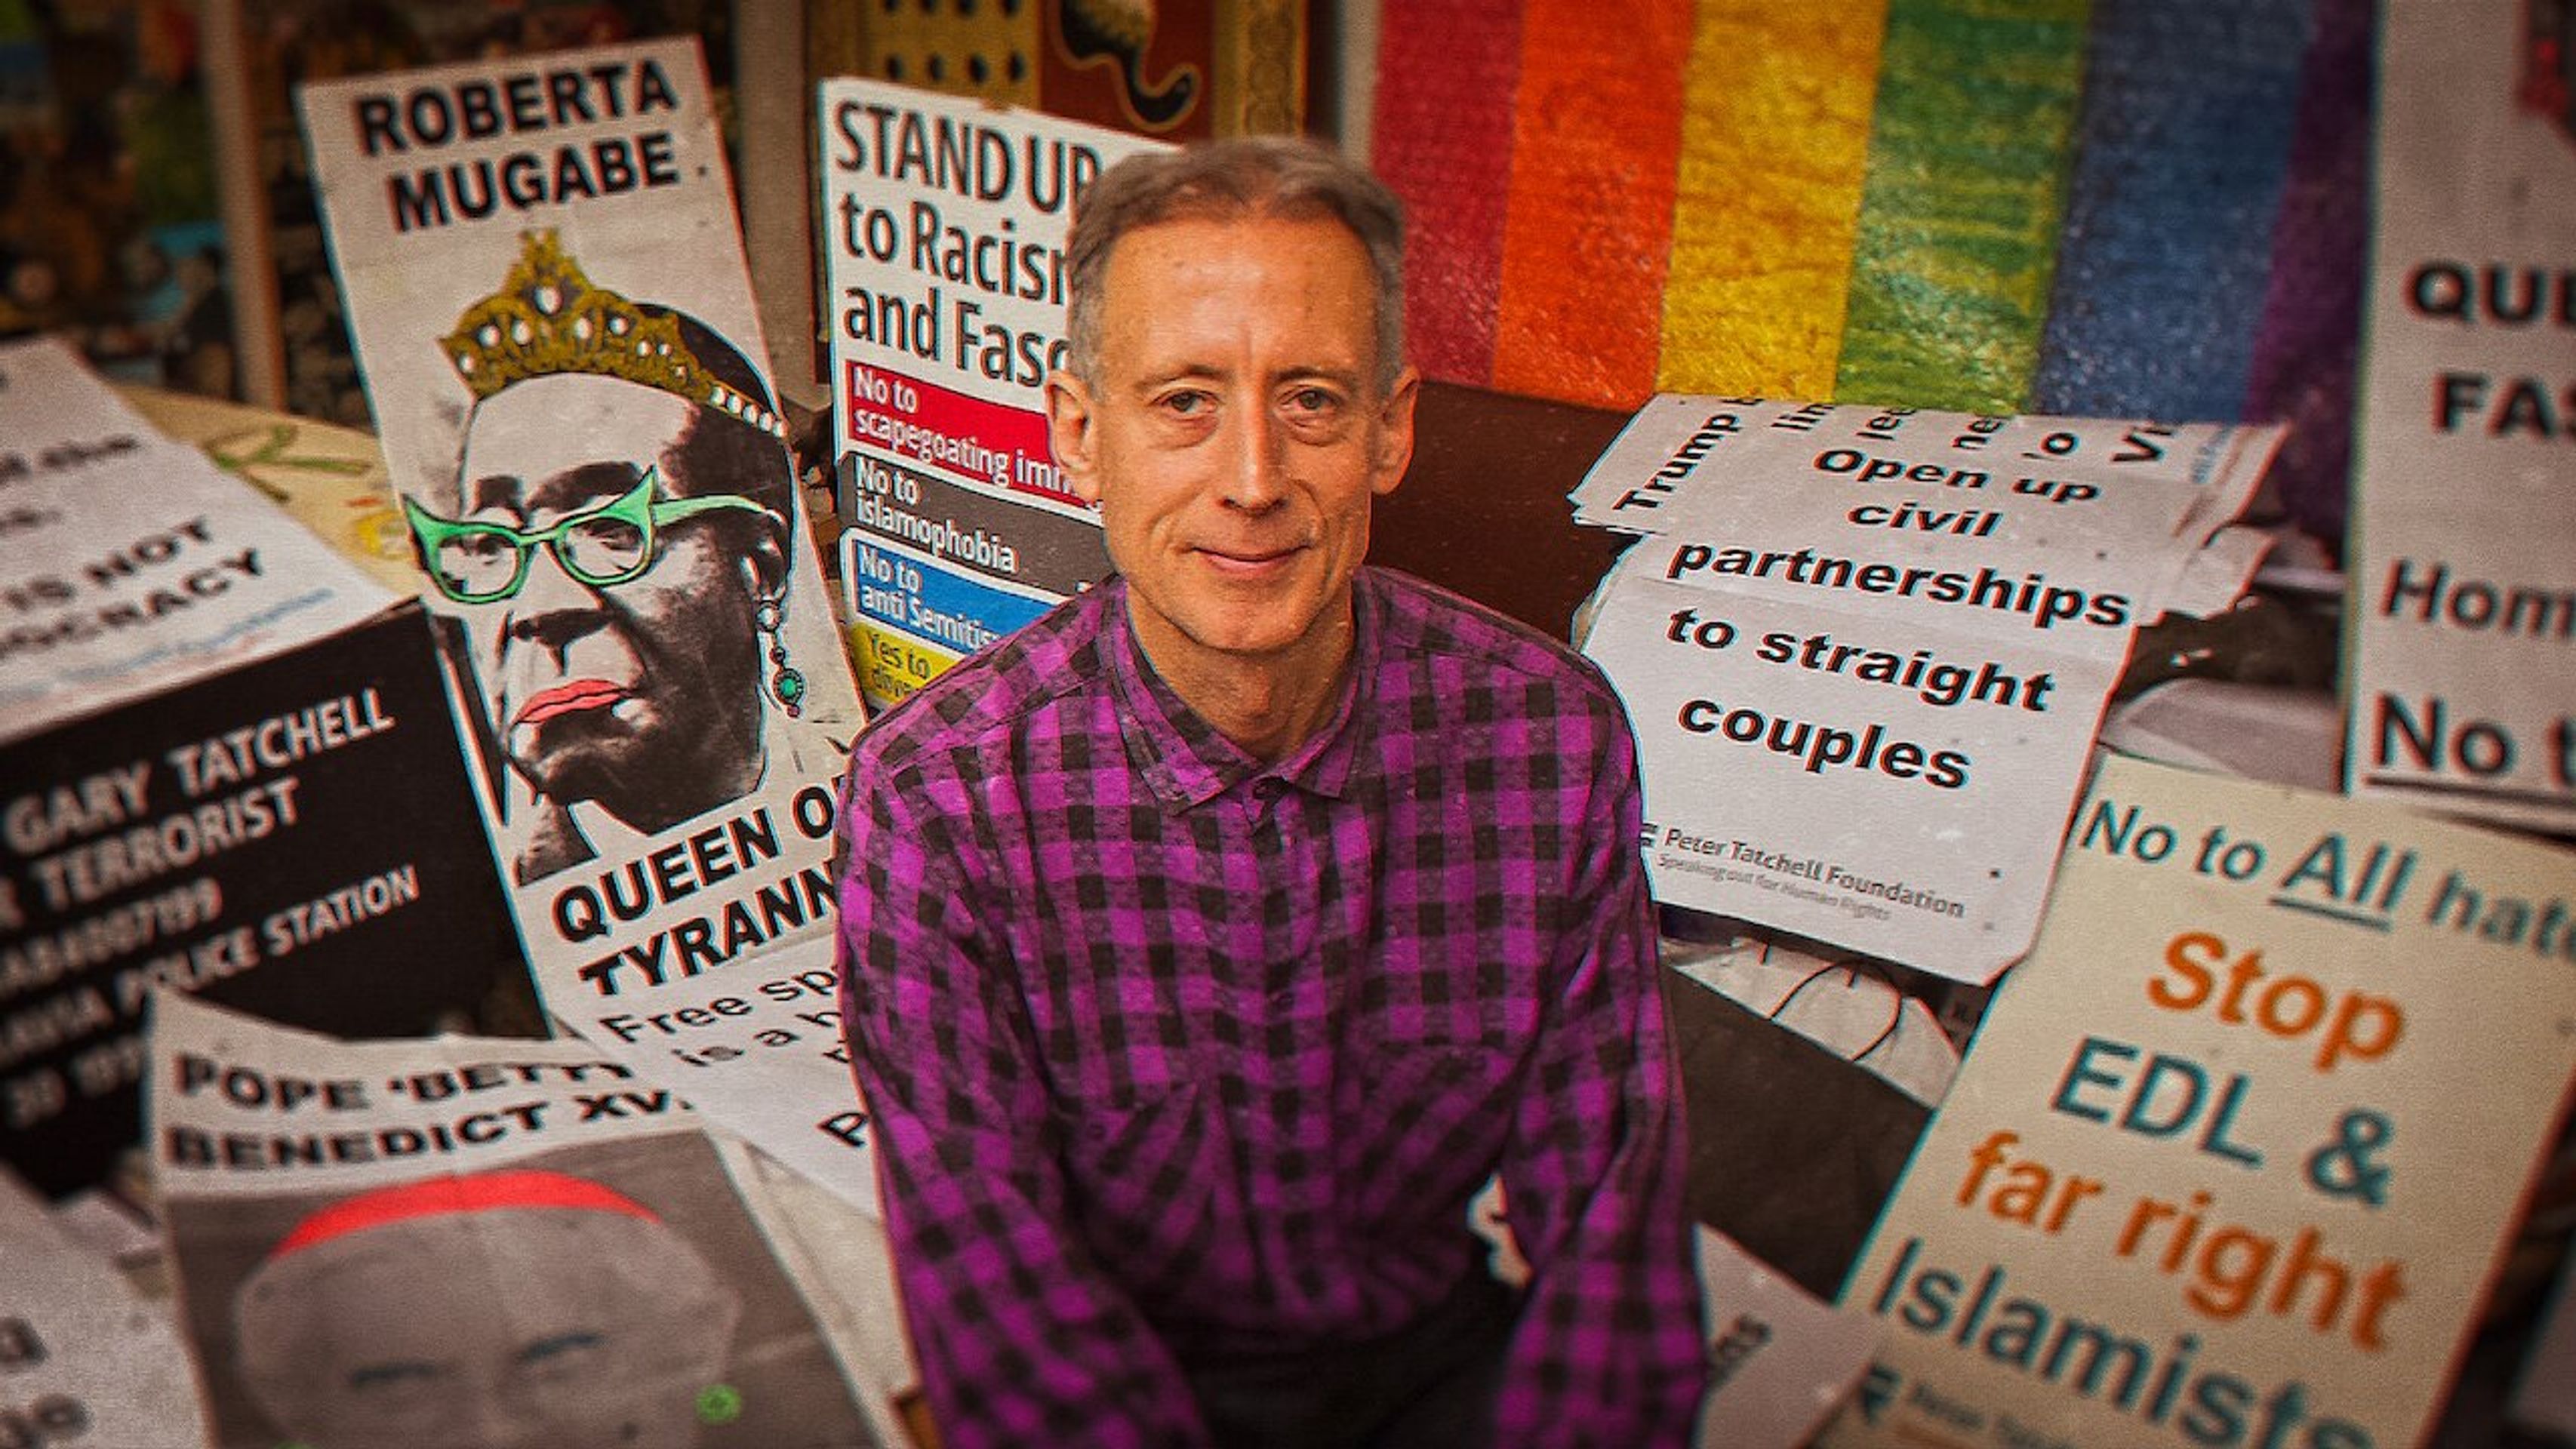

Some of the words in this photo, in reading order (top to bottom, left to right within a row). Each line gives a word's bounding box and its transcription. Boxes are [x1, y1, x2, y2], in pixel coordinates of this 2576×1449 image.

[353, 59, 676, 156] ROBERTA
[836, 100, 1015, 202] STAND
[388, 131, 678, 232] MUGABE
[839, 193, 898, 264] to
[843, 287, 941, 362] and
[853, 368, 888, 405] No
[892, 375, 919, 414] to
[853, 408, 1009, 488] scapegoating
[855, 456, 889, 492] No
[892, 466, 919, 506] to
[1612, 414, 1742, 510] Trump
[1813, 449, 1993, 490] Open
[2011, 478, 2100, 502] up
[83, 516, 210, 589] NOT
[857, 488, 1019, 574] islamophobia
[1847, 501, 2002, 537] civil
[860, 545, 893, 583] No
[895, 554, 921, 593] to
[860, 584, 904, 621] anti
[1666, 540, 2132, 628] partnerships
[871, 632, 903, 670] Yes
[907, 649, 931, 680] to
[1666, 608, 1736, 649] to
[1755, 631, 2056, 711] straight
[2, 761, 152, 857] GARY
[168, 687, 395, 798] TATCHELL
[1678, 699, 1971, 789] couples
[2371, 691, 2515, 780] No
[34, 776, 301, 912] TERRORIST
[552, 808, 781, 943] QUEEN
[1664, 828, 1727, 856] Peter
[1730, 839, 1823, 880] Tatchell
[1827, 865, 1967, 918] Foundation
[2079, 800, 2176, 864] No
[2195, 826, 2265, 881] to
[2281, 832, 2417, 915] All
[262, 866, 420, 957] STATION
[599, 996, 753, 1042] Free
[757, 964, 839, 1001] sp
[2148, 930, 2405, 1073] Stop
[172, 1054, 371, 1113] POPE
[2051, 1034, 2264, 1170] EDL
[2304, 1108, 2394, 1209] &
[163, 1100, 549, 1170] BENEDICT
[1955, 1128, 2104, 1236] far
[2116, 1189, 2408, 1352] right
